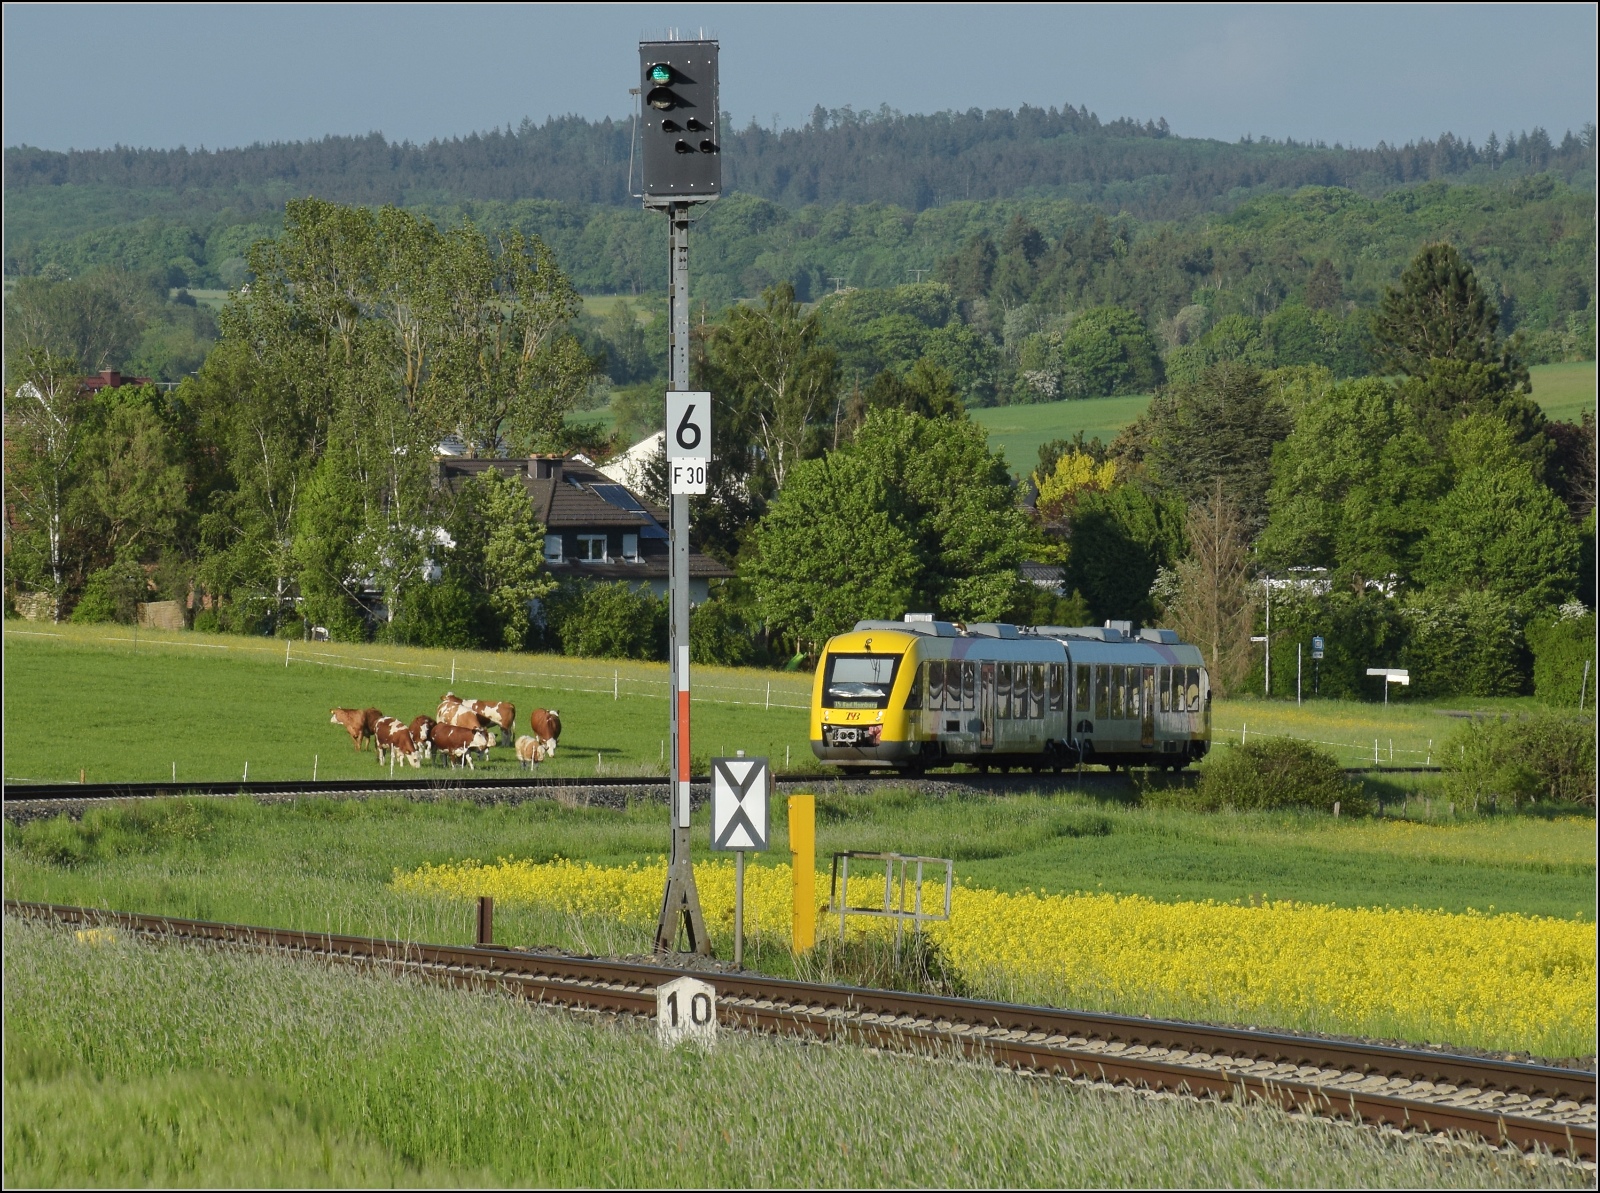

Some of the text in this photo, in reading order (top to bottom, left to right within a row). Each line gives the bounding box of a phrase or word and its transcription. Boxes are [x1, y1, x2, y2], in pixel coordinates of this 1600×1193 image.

[676, 404, 701, 450] 6
[674, 467, 704, 484] F 30
[667, 990, 712, 1027] 10
